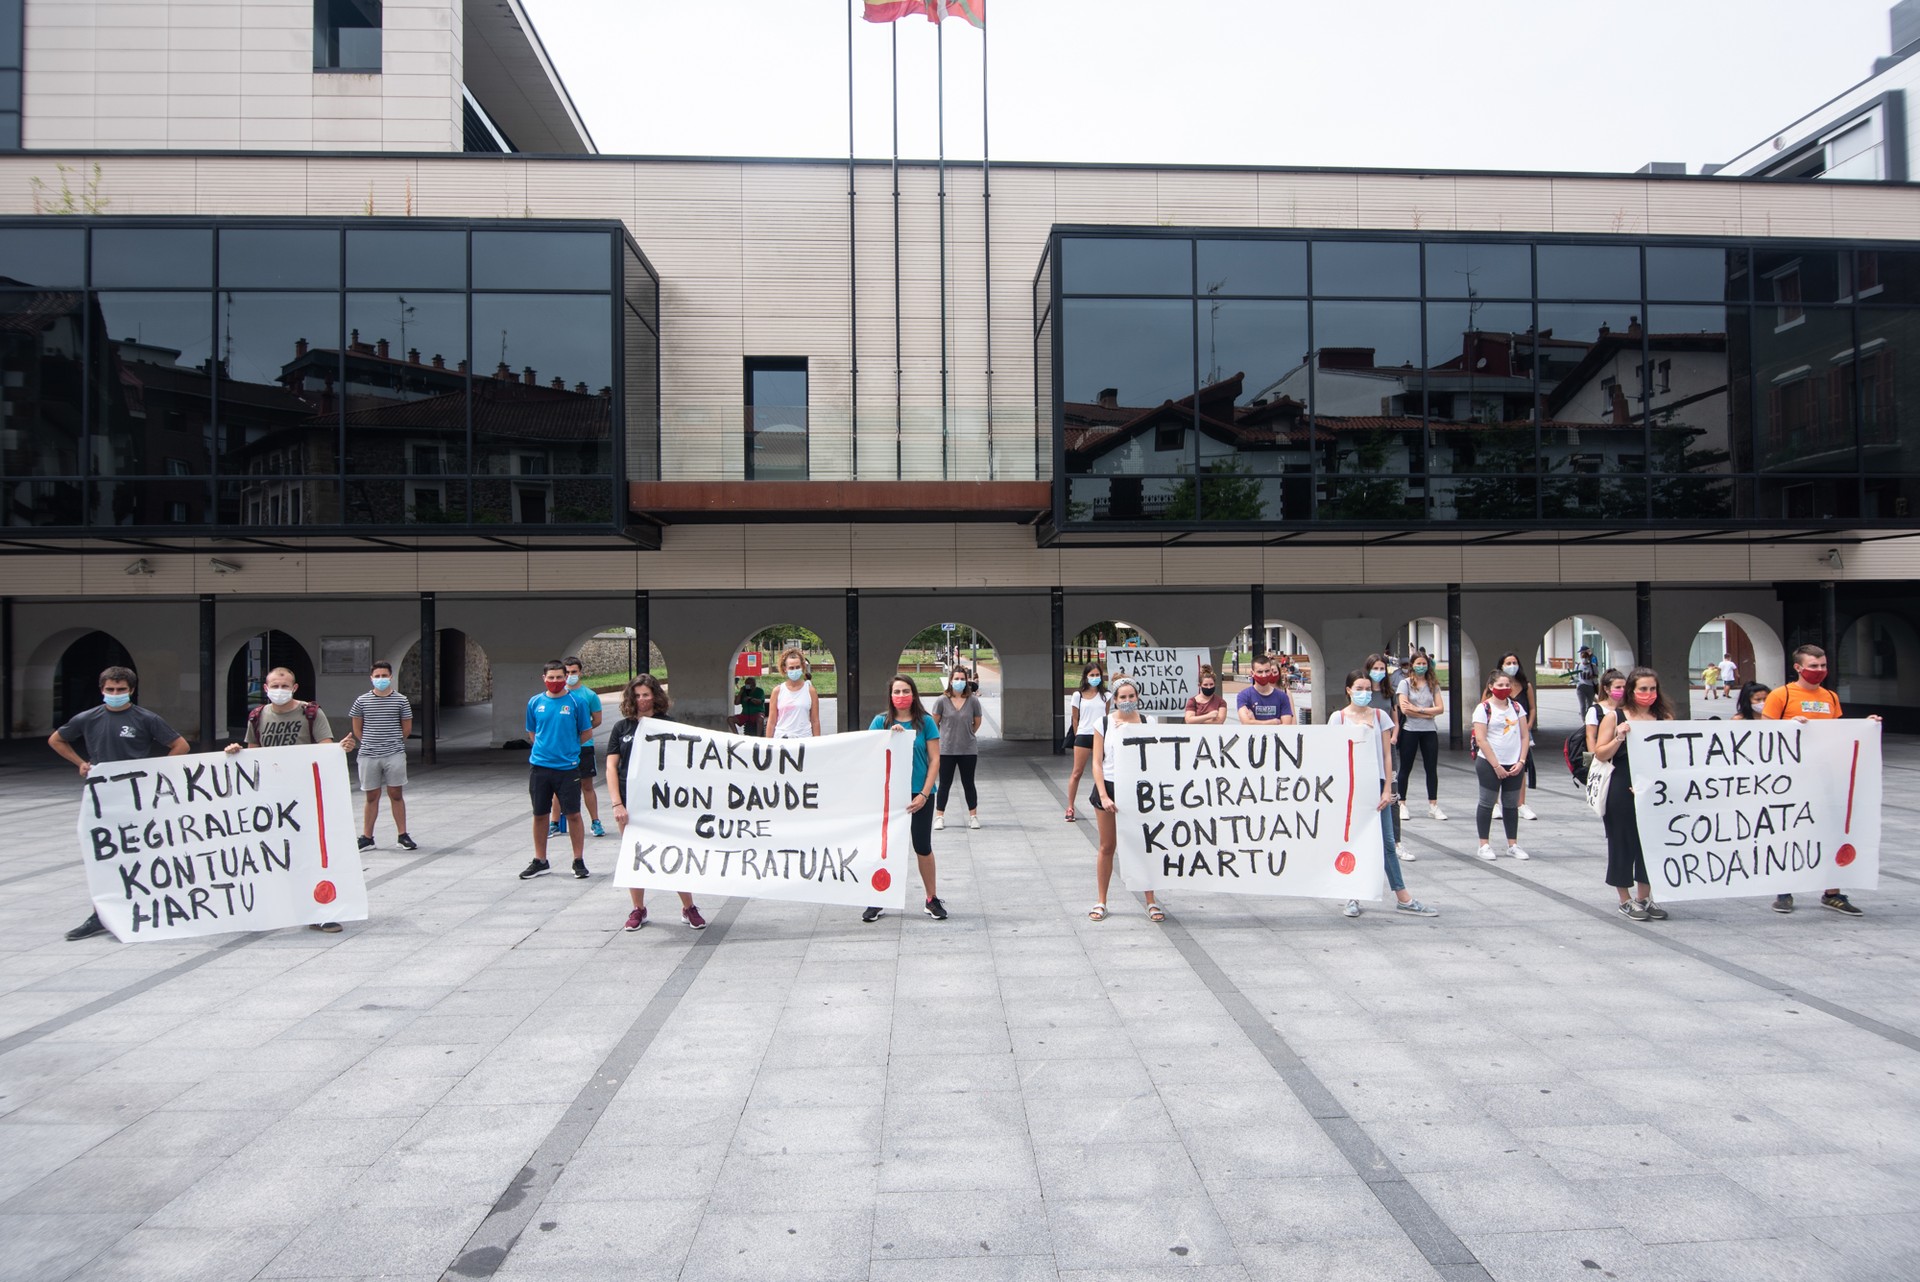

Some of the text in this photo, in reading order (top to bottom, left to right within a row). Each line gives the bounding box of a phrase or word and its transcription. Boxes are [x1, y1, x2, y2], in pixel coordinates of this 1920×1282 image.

[1111, 650, 1177, 664] TTAKUN
[1132, 665, 1183, 676] ASTEKO
[645, 732, 806, 773] TTAKUN
[1122, 733, 1304, 771] TTAKUN
[1644, 729, 1802, 769] TTAKUN
[85, 760, 260, 819] TTAKUN
[652, 782, 819, 810] NON DAUDE
[1136, 775, 1334, 813] BEGIRALEOK
[1684, 773, 1793, 801] ASTEKO
[91, 800, 301, 861] BEGIRALEOK
[695, 813, 772, 839] GURE
[1141, 809, 1320, 854] KONTUAN
[1664, 801, 1816, 847] SOLDATA
[119, 838, 291, 899] KONTUAN
[632, 841, 859, 883] KONTRATUAK
[1163, 848, 1287, 879] HARTU
[132, 882, 255, 932] HARTU
